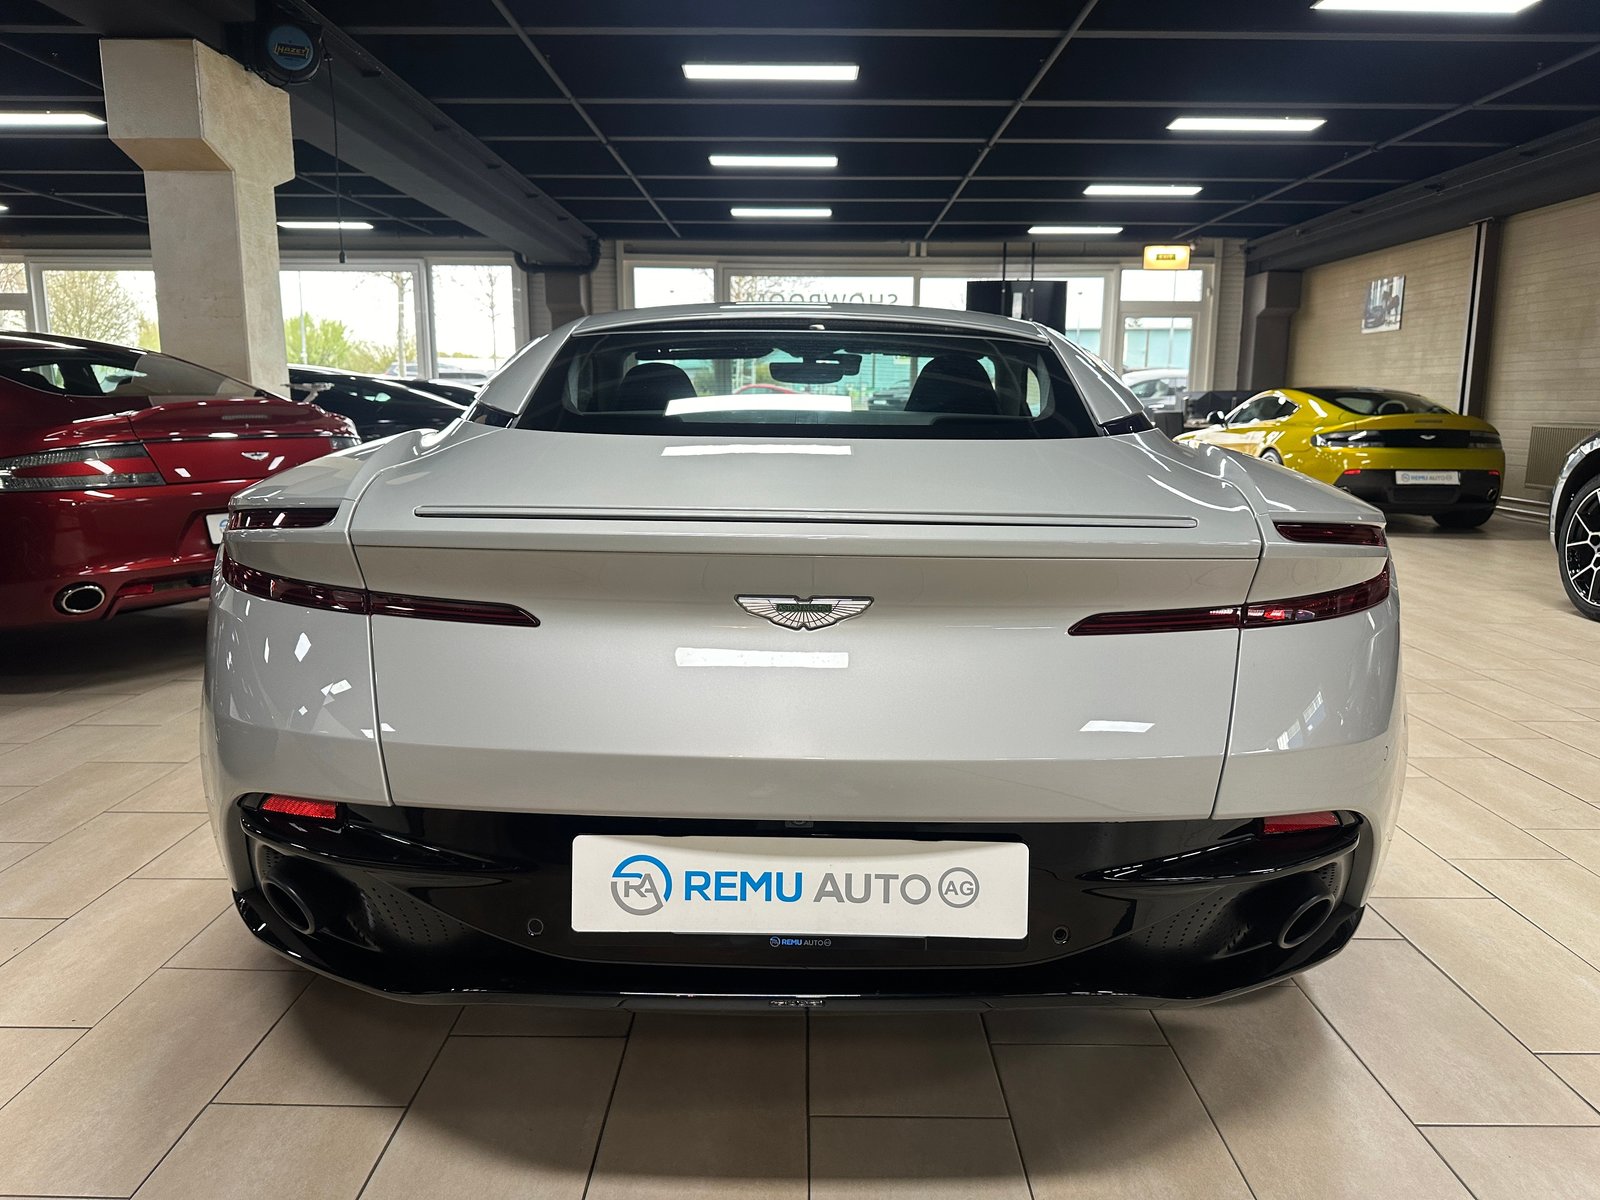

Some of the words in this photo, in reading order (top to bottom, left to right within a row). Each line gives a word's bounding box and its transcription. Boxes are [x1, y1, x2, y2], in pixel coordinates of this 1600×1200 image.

[277, 45, 305, 53] HAZET
[684, 870, 803, 902] REMU
[813, 872, 932, 906] AUTO
[943, 879, 975, 897] AG
